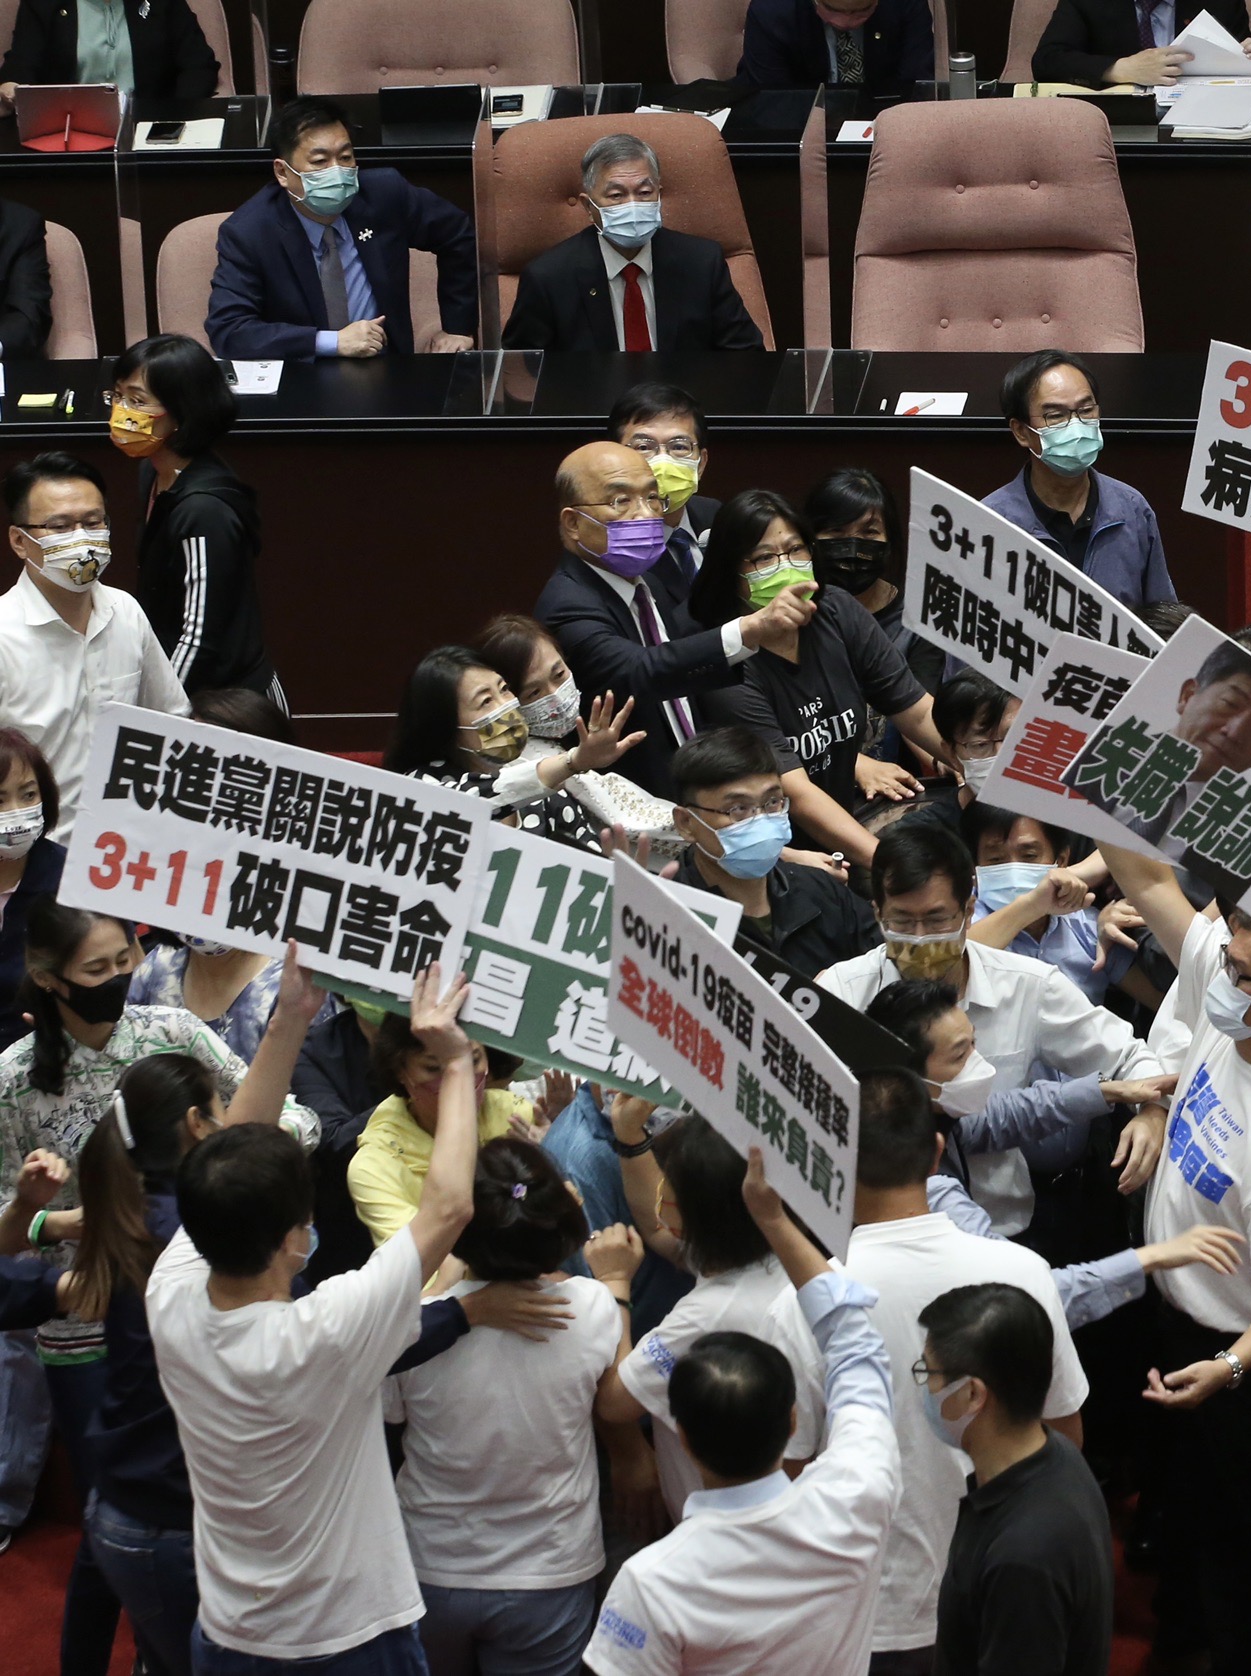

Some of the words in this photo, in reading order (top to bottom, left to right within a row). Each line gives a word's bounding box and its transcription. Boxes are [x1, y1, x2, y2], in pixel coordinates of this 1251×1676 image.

[921, 563, 1049, 683] 陳時中
[929, 504, 1159, 660] 3+11破口害人
[103, 725, 473, 892] 民進黨關說防疫
[1074, 715, 1203, 822] 失職
[88, 831, 452, 981] 3+11破口害命
[617, 954, 726, 1091] 全球倒數
[621, 905, 755, 1051] covid-19疫苗
[1207, 1114, 1231, 1142] Needs
[1218, 1107, 1244, 1137] Taiwan
